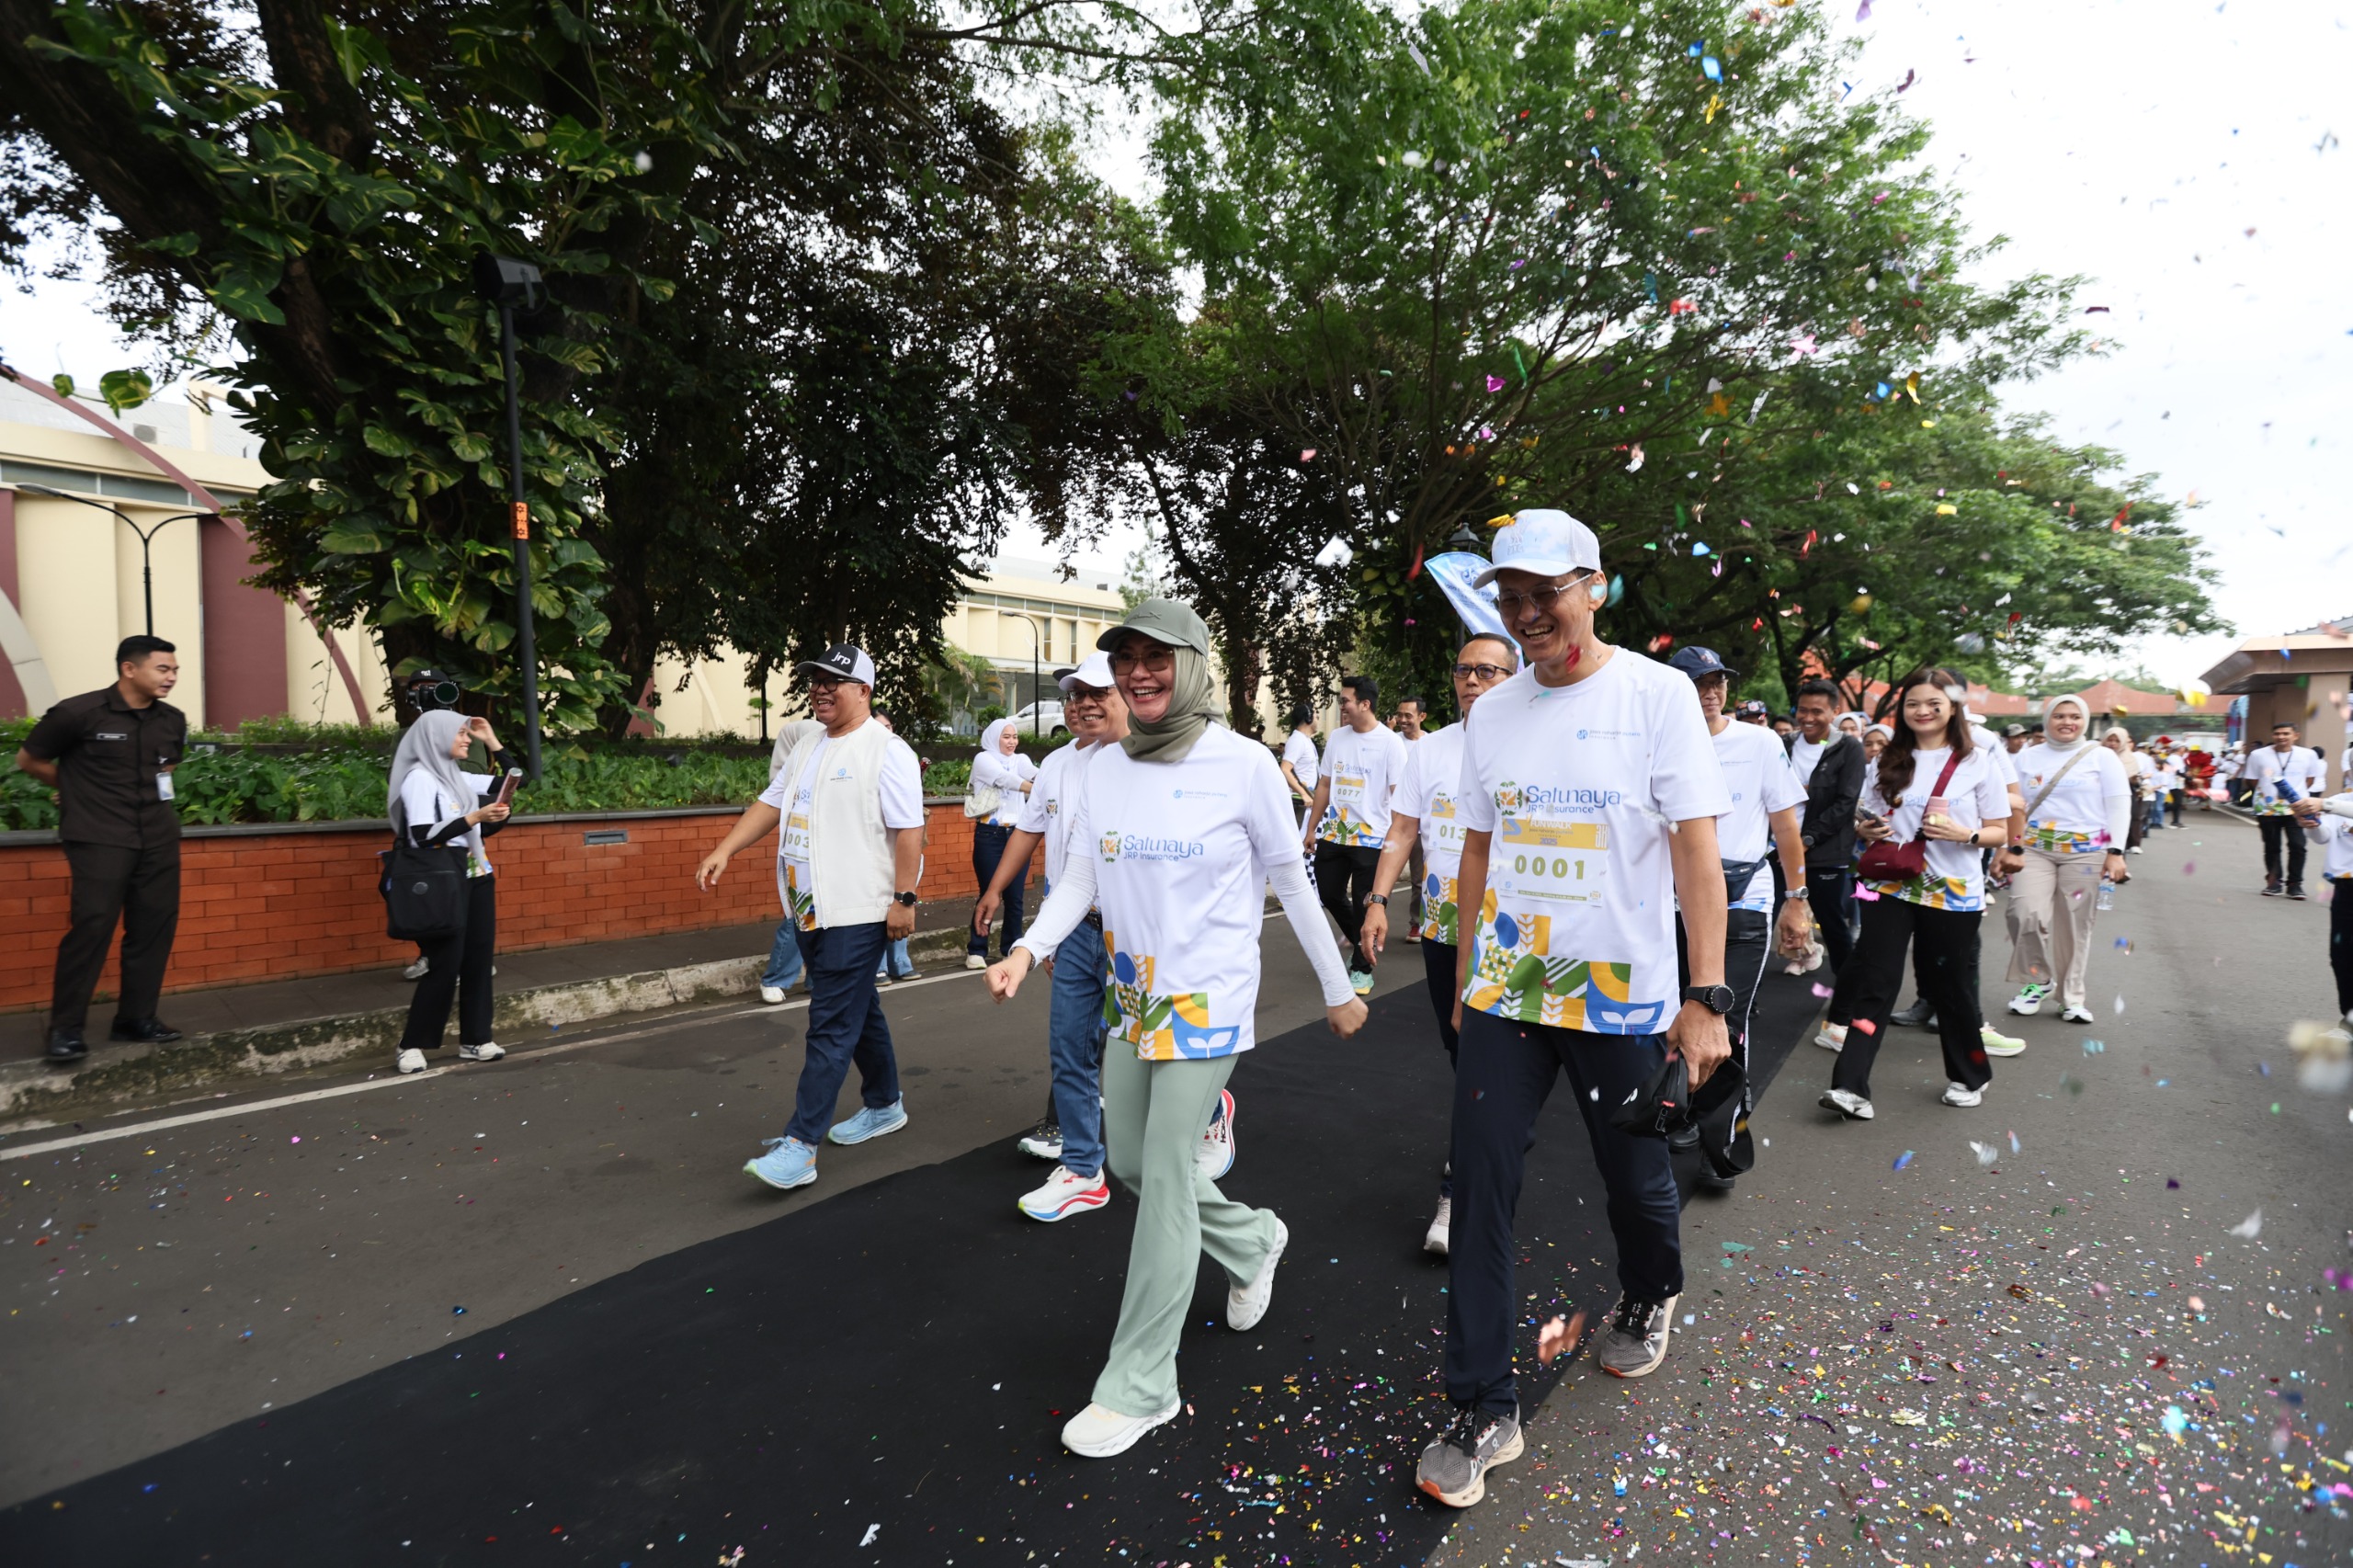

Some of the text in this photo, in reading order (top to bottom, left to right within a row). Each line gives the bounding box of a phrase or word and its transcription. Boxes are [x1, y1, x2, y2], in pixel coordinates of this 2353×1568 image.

[831, 652, 851, 665] jrp
[1337, 788, 1360, 797] 0077
[1123, 851, 1179, 861] JRP Insurance
[1514, 854, 1585, 881] 0001
